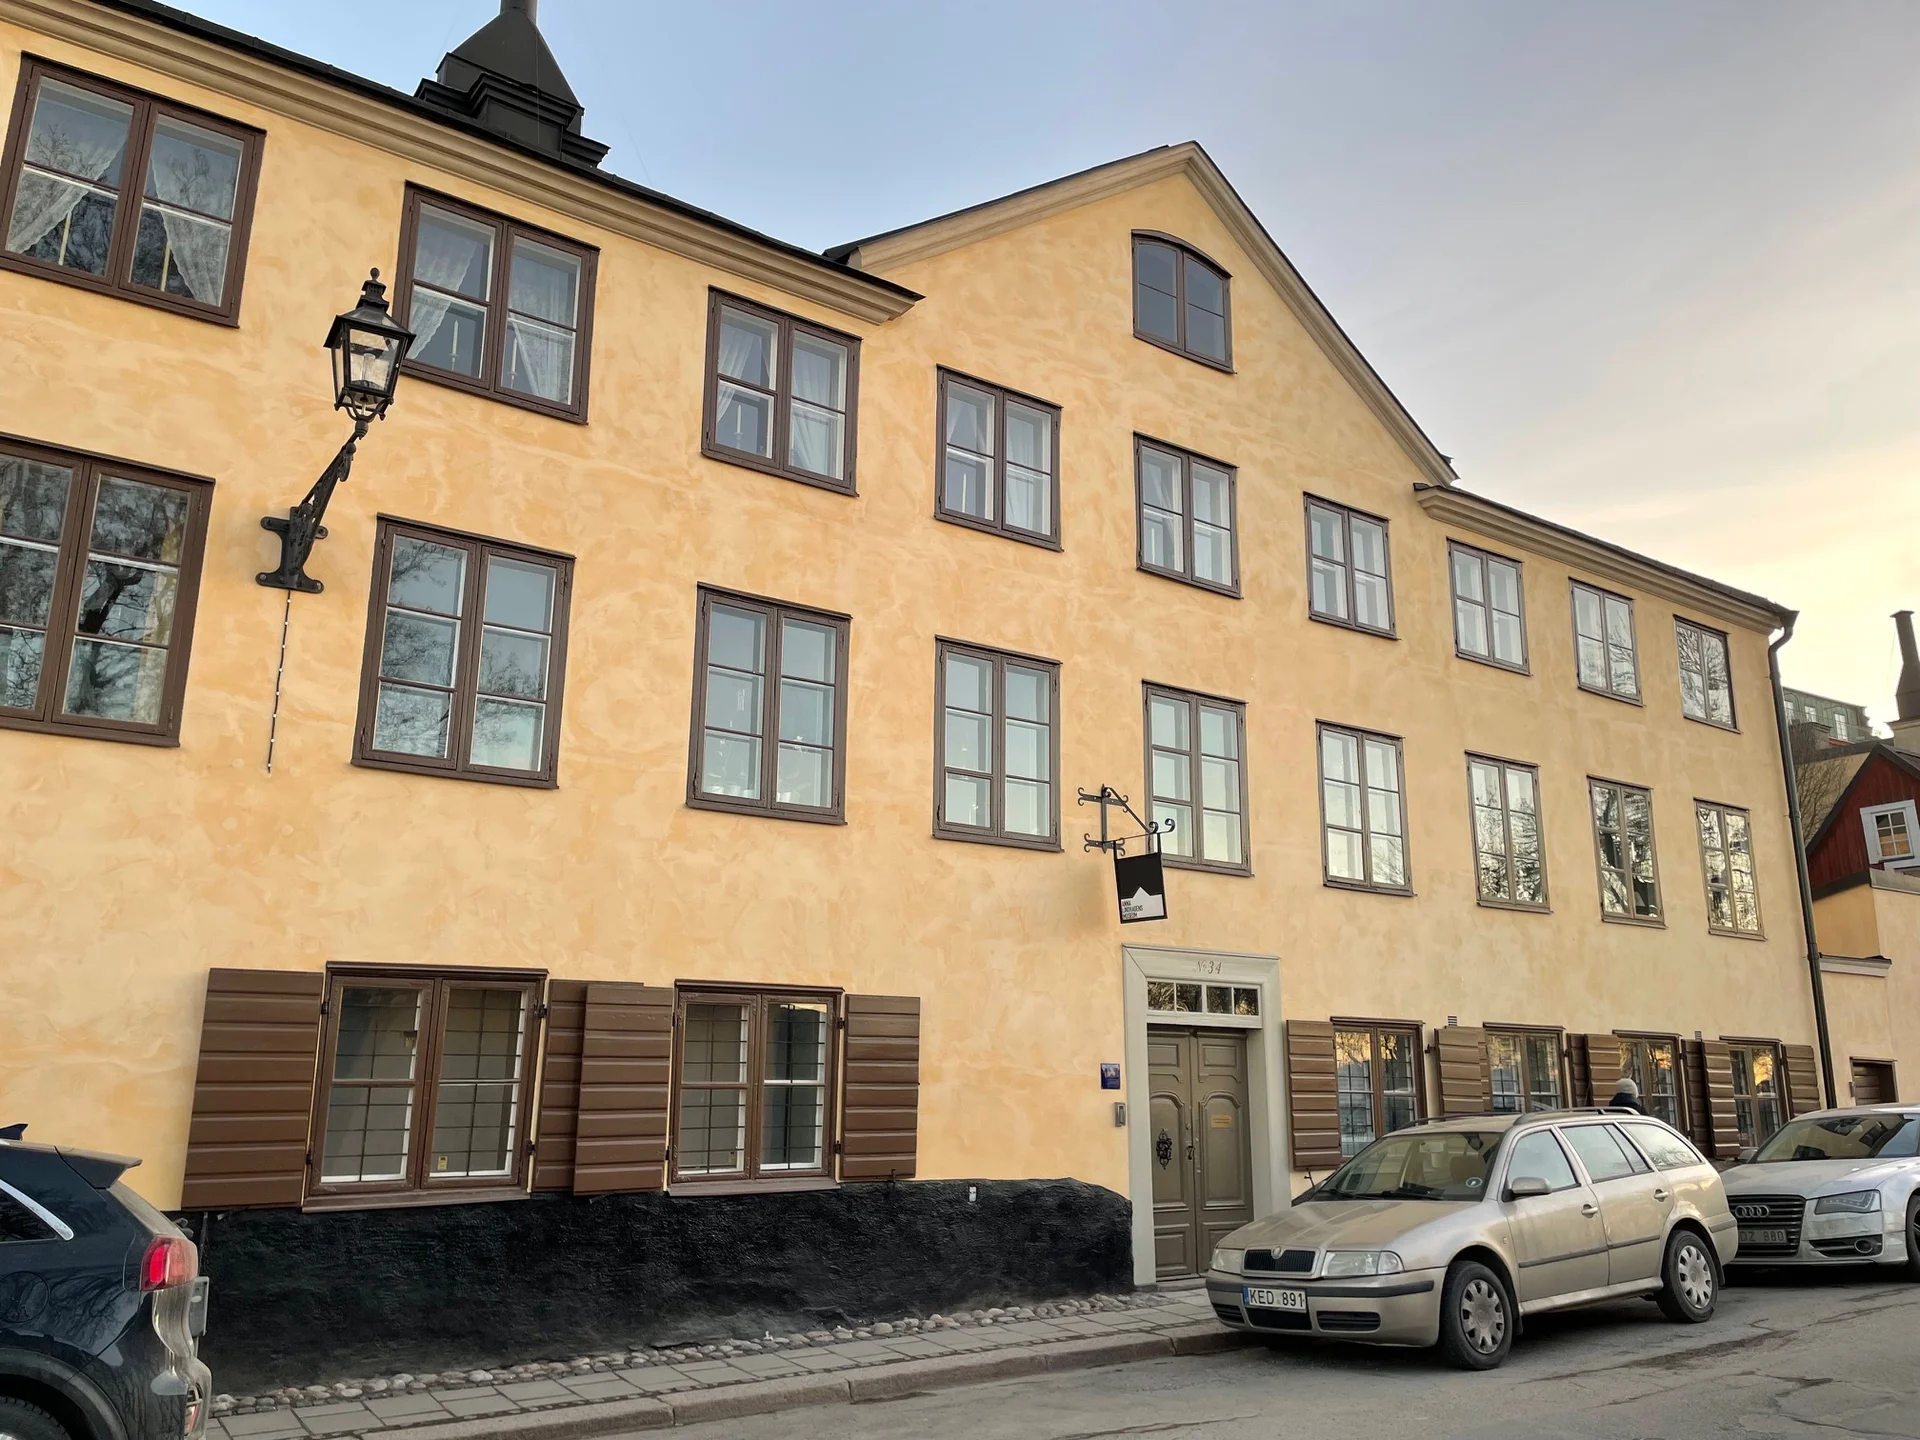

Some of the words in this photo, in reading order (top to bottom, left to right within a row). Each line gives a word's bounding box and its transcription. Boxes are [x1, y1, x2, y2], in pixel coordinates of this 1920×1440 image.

[1739, 1231, 1756, 1241] DZ
[1249, 1289, 1274, 1305] KED
[1282, 1291, 1303, 1308] 891
